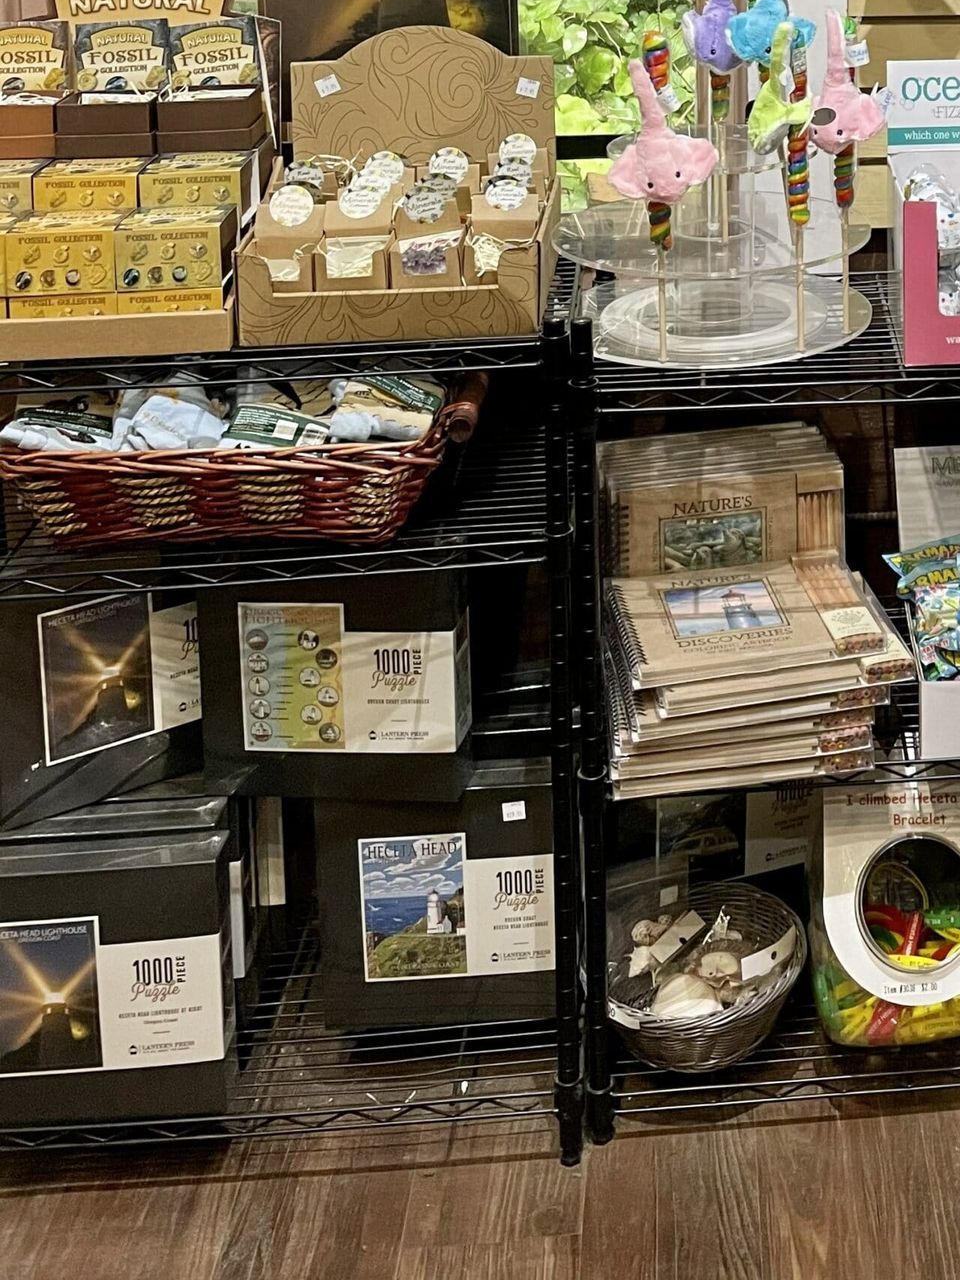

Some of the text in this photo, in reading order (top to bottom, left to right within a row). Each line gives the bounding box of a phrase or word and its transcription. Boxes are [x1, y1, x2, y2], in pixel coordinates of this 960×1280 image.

[97, 33, 148, 47] NATURAL
[187, 33, 238, 48] NATURAL
[0, 50, 57, 65] OSSIL
[88, 48, 158, 65] FOSSIL
[179, 47, 248, 67] FOSSIL
[904, 130, 931, 140] which
[933, 131, 950, 139] one
[673, 496, 752, 516] NATURE'S
[677, 628, 793, 648] DISCOVERIES
[373, 648, 410, 675] 1000
[412, 649, 422, 675] PIECE
[371, 671, 417, 691] Puzzle
[846, 794, 853, 806] I
[859, 793, 907, 805] climbed
[893, 813, 946, 826] Bracelet
[367, 842, 457, 859] HECETA HEAD
[496, 869, 532, 895] 1000
[535, 868, 544, 894] PIECE
[493, 893, 539, 911] Puzzle
[20, 925, 87, 938] HEAD LIGHTHOUSE
[132, 957, 173, 986] 1000
[176, 955, 186, 983] PIECE
[130, 981, 180, 1002] Puzzle
